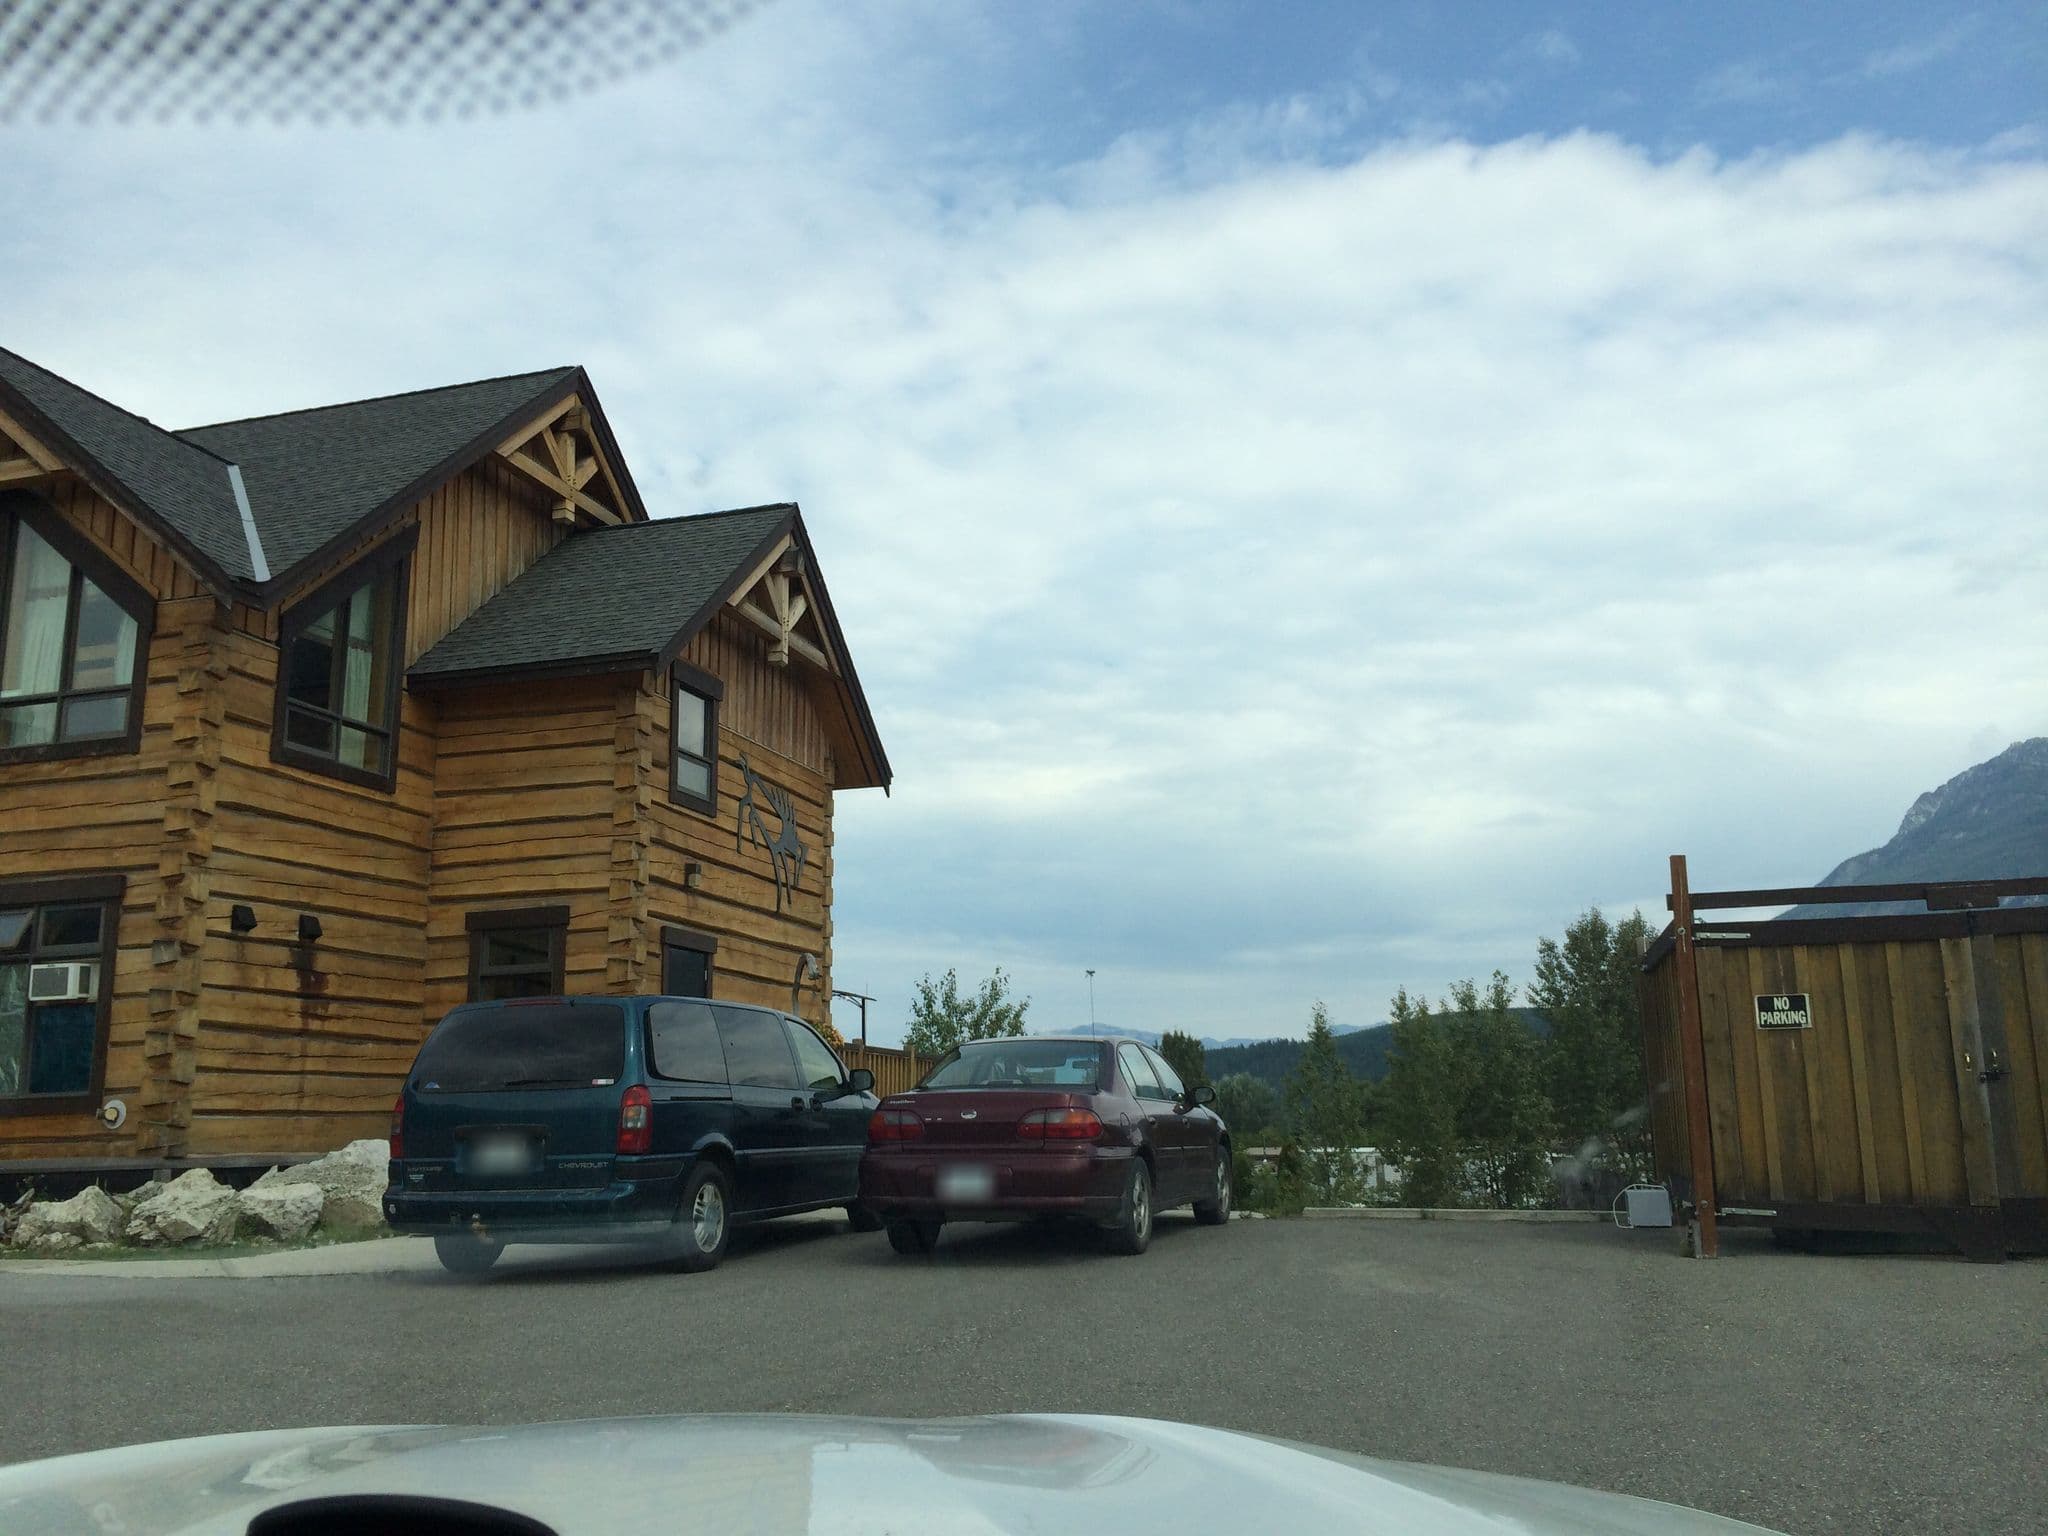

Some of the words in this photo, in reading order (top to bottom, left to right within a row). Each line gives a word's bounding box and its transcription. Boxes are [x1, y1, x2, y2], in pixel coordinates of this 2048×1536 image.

[1773, 997, 1790, 1010] NO
[1760, 1011, 1807, 1025] PARKING
[558, 1161, 609, 1169] CHEVROLET
